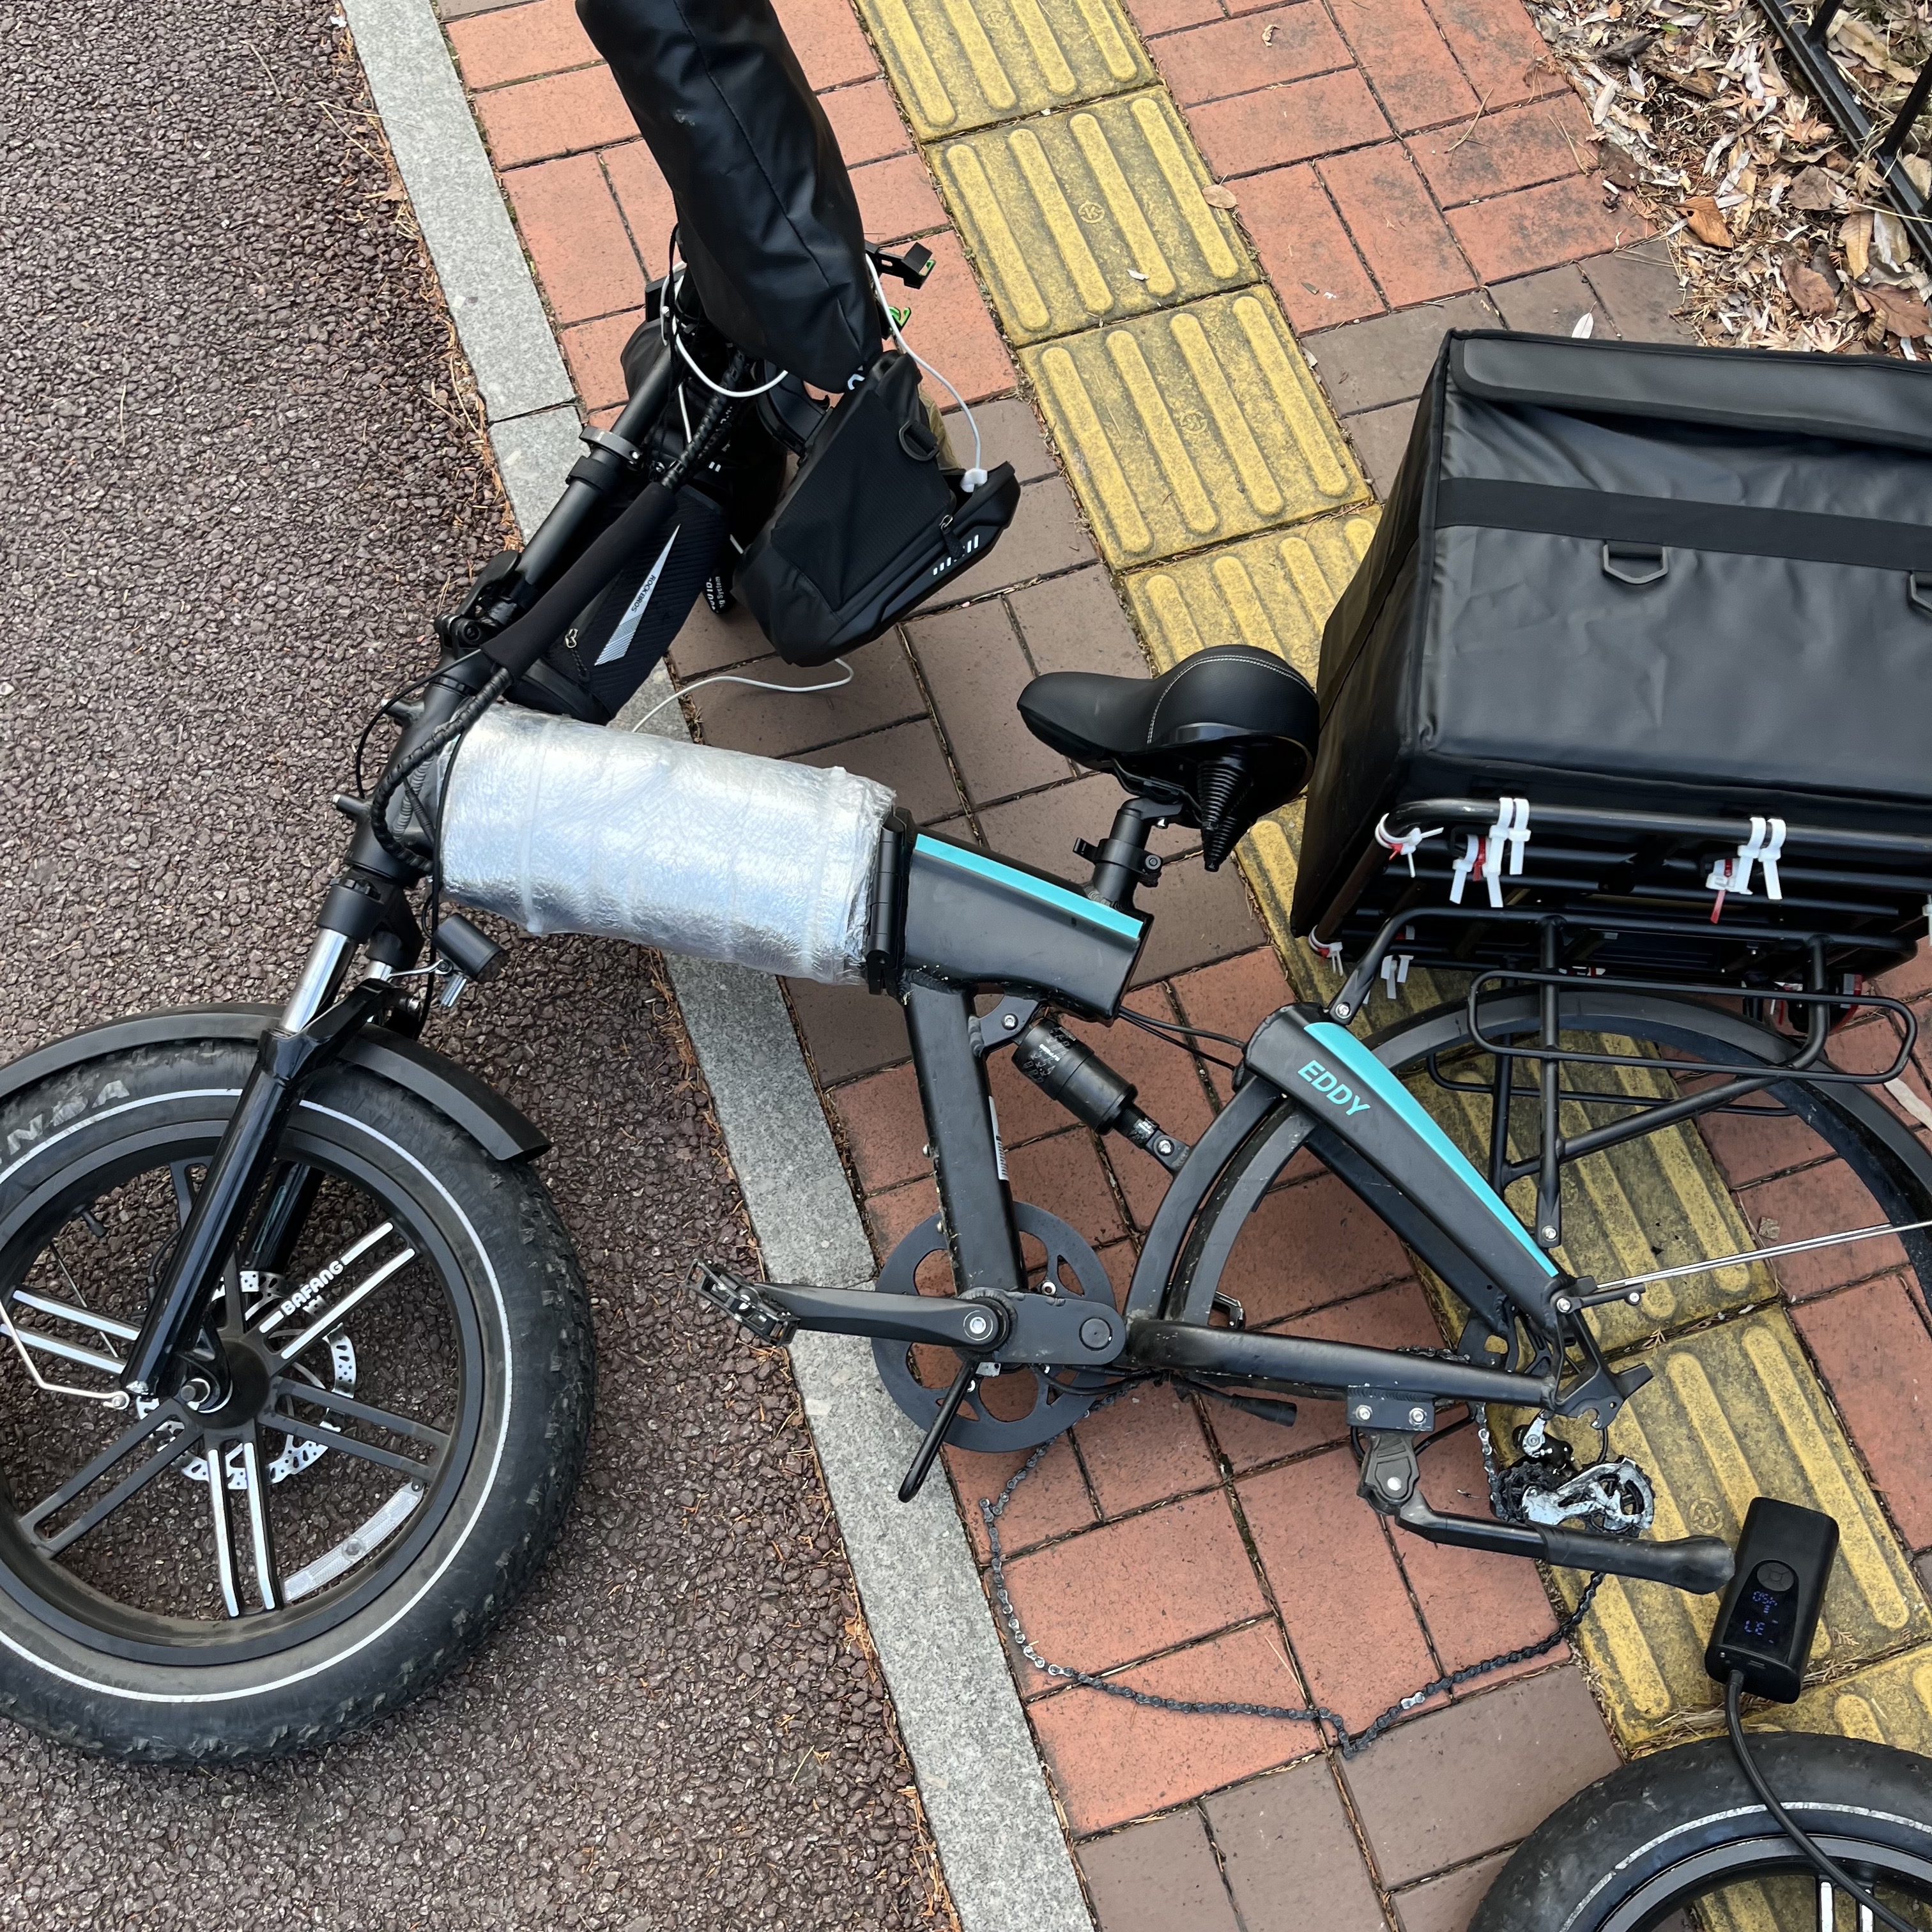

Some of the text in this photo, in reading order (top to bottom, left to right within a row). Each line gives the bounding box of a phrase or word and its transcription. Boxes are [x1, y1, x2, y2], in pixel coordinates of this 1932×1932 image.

[631, 575, 656, 613] ROCKBROS
[1298, 1060, 1370, 1116] EDDY
[280, 1261, 344, 1315] BAFANG
